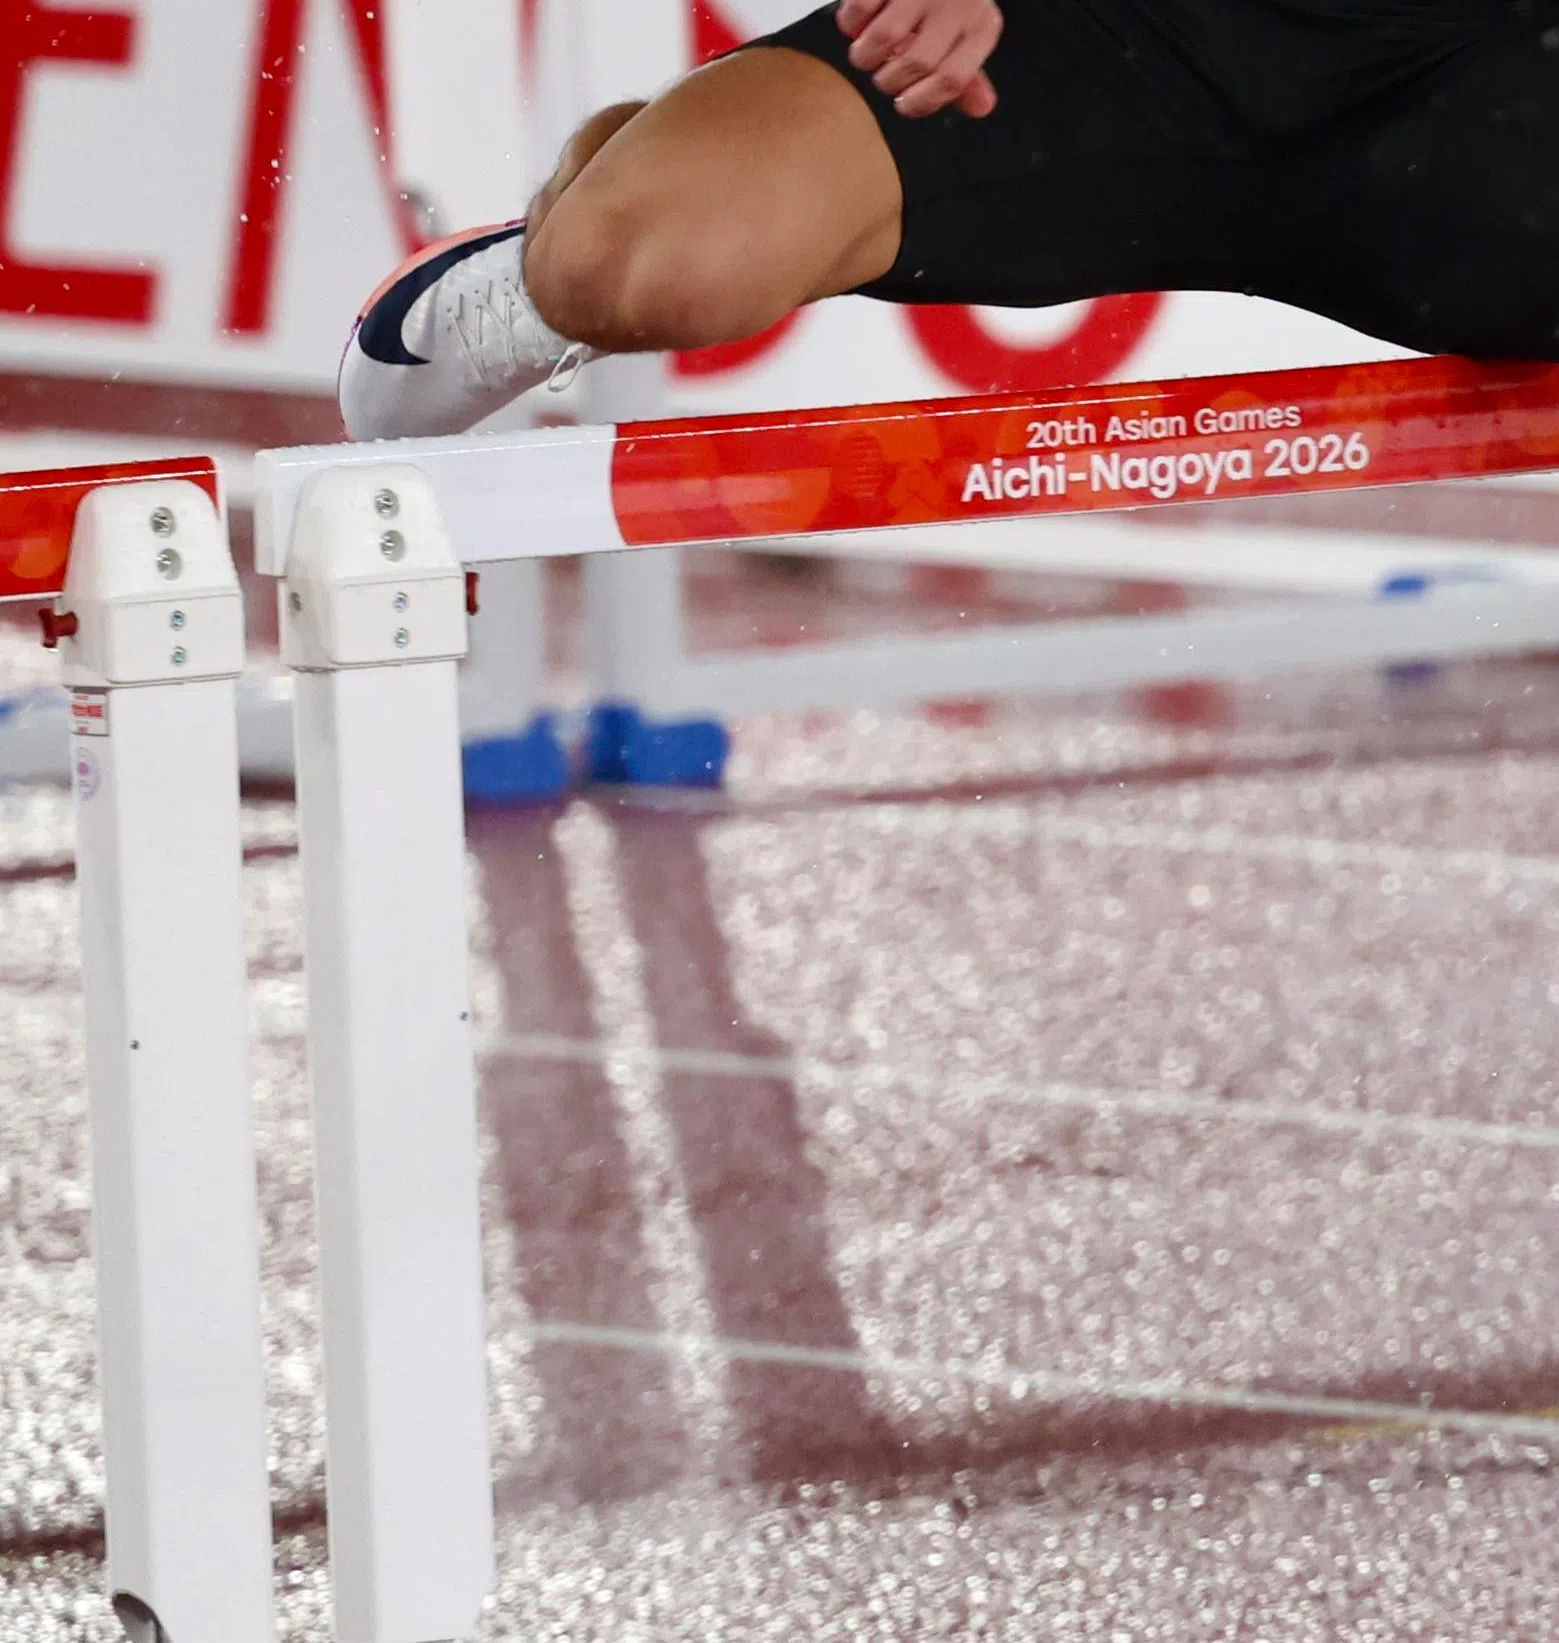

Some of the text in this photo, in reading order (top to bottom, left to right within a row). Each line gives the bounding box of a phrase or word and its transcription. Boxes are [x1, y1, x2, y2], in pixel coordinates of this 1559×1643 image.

[1026, 404, 1301, 449] 20th Asian Games
[961, 432, 1371, 503] Aichi-Nagoya 2026
